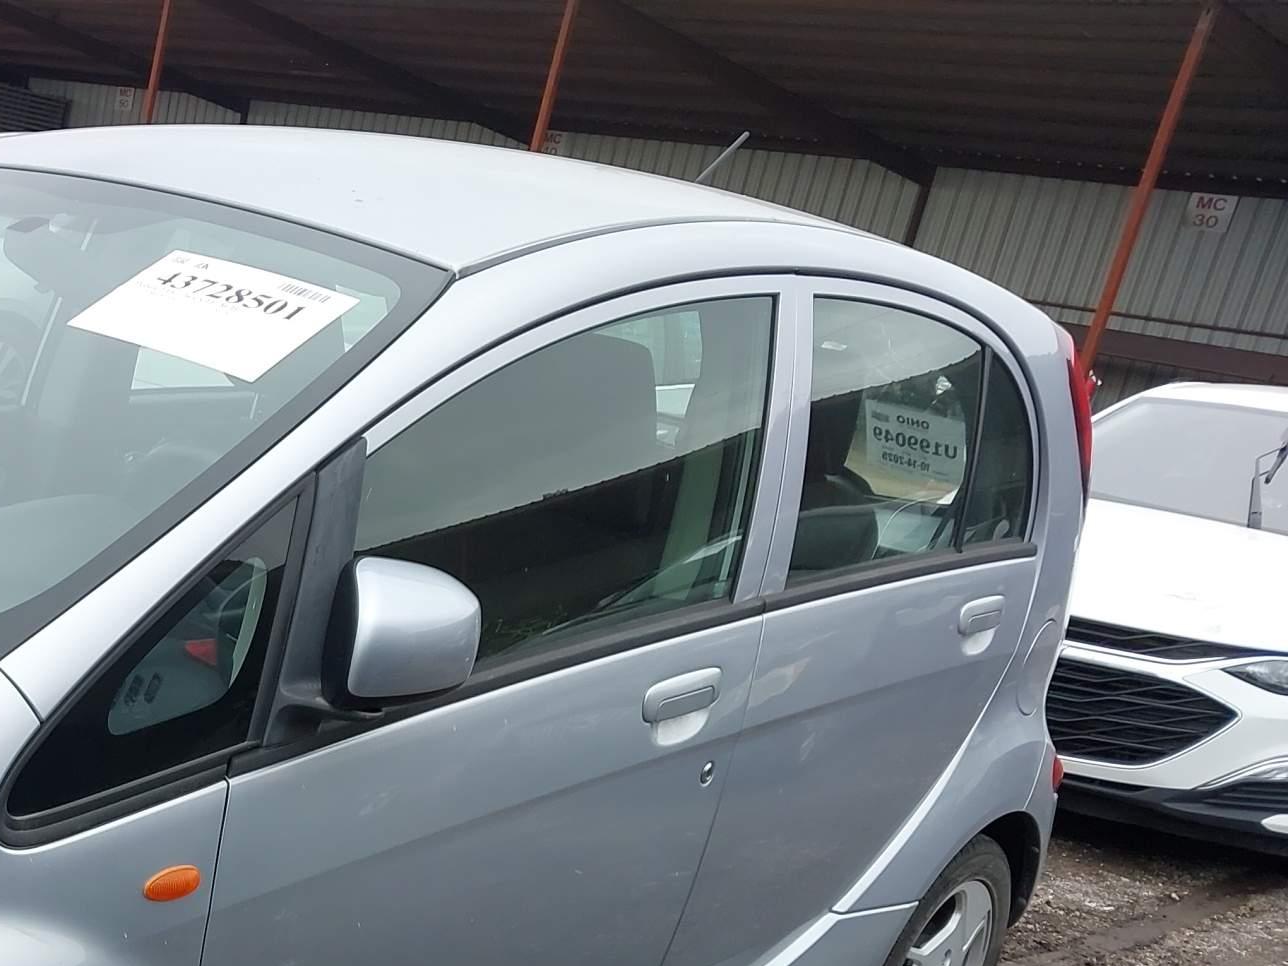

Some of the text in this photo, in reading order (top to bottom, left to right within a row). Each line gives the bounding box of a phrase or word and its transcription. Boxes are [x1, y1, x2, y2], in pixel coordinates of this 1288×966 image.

[1196, 196, 1228, 211] MC
[1192, 213, 1219, 229] 30
[156, 271, 306, 321] 43728501
